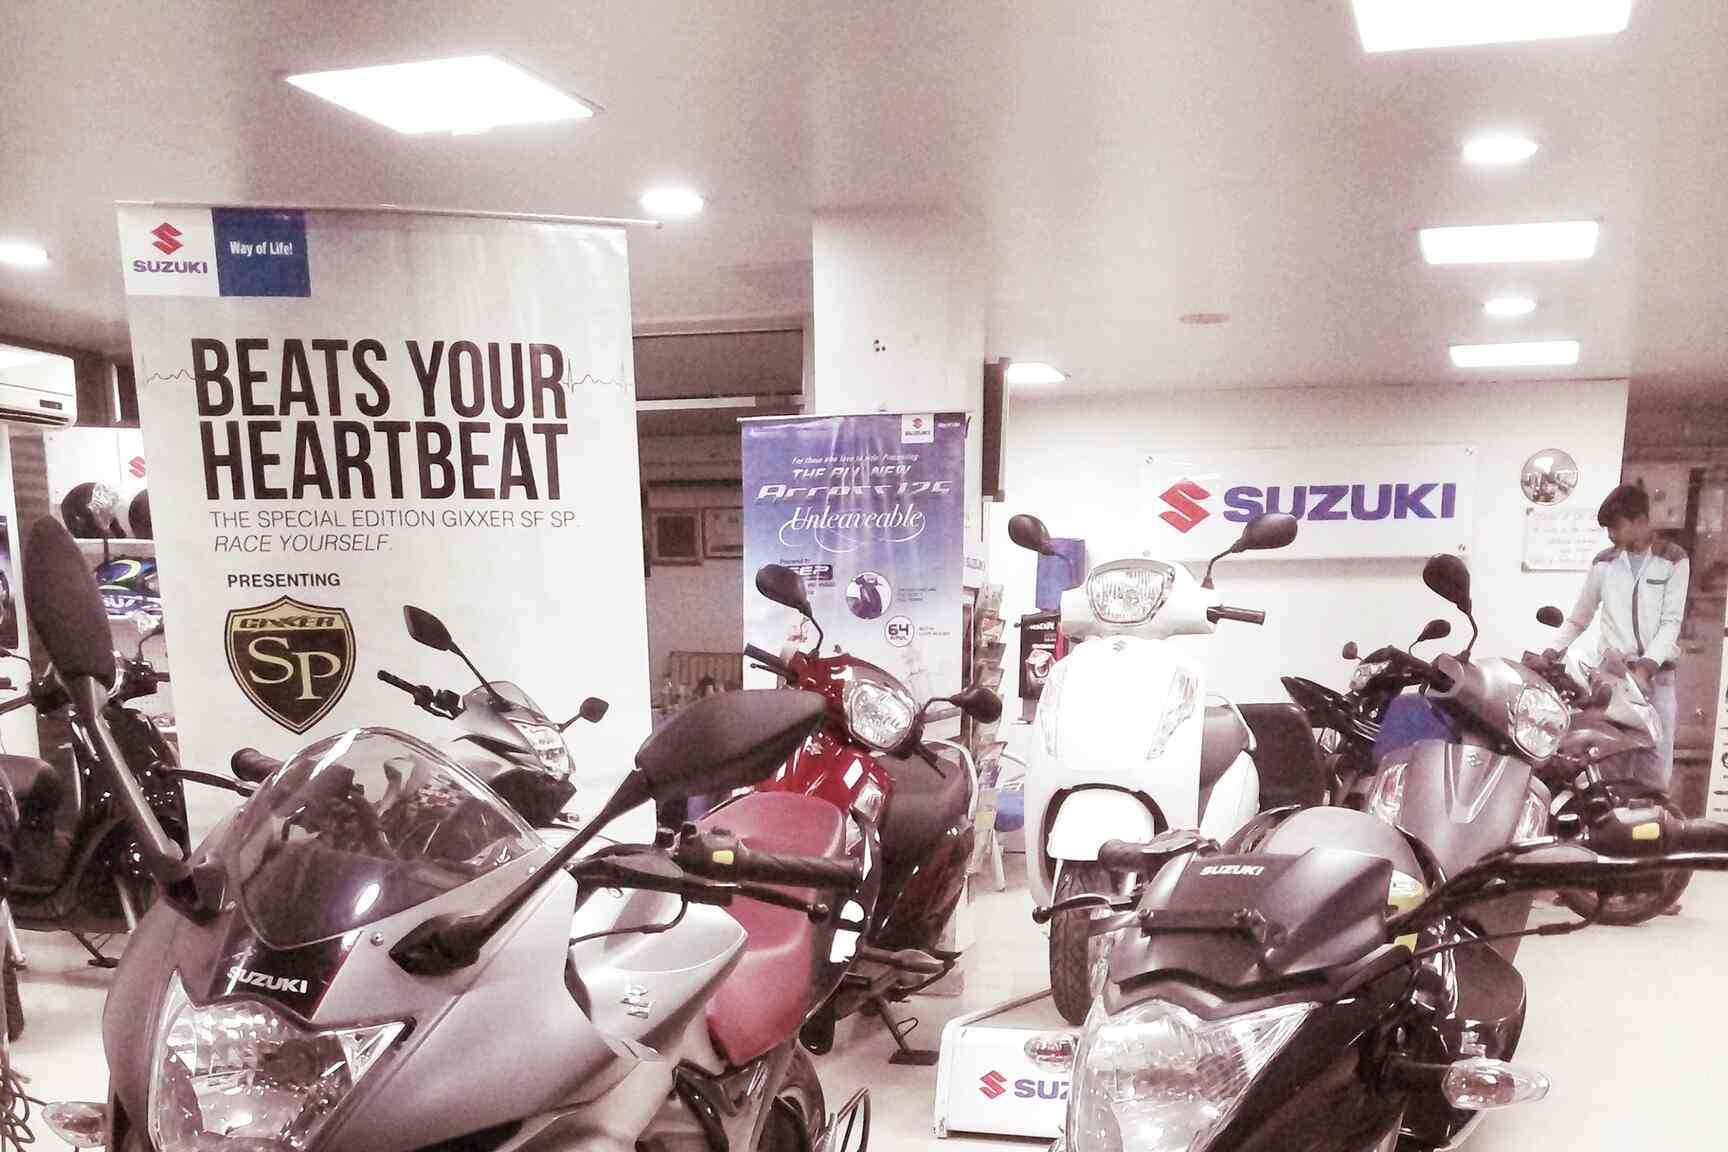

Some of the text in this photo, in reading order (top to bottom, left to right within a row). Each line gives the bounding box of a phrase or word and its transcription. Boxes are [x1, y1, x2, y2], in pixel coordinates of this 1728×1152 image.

[229, 240, 293, 257] Way of Life!
[133, 260, 208, 274] SUZUKI
[191, 338, 568, 419] BEATS YOUR
[199, 420, 569, 500] HEARTBEAT
[897, 481, 953, 495] 125
[1223, 483, 1457, 523] SUZUKI
[209, 511, 250, 528] THE
[257, 510, 346, 528] SPECIAL
[352, 509, 435, 527] EDITION
[441, 510, 515, 528] GIXXER
[521, 510, 544, 528] SF
[785, 503, 925, 536] Unleaveable
[214, 534, 392, 552] RACE YOURSELF.
[227, 572, 341, 588] PRESENTING
[888, 624, 909, 636] 64
[248, 636, 341, 700] SP
[1200, 865, 1264, 876] SUZUKI
[227, 966, 308, 994] SUZUKI
